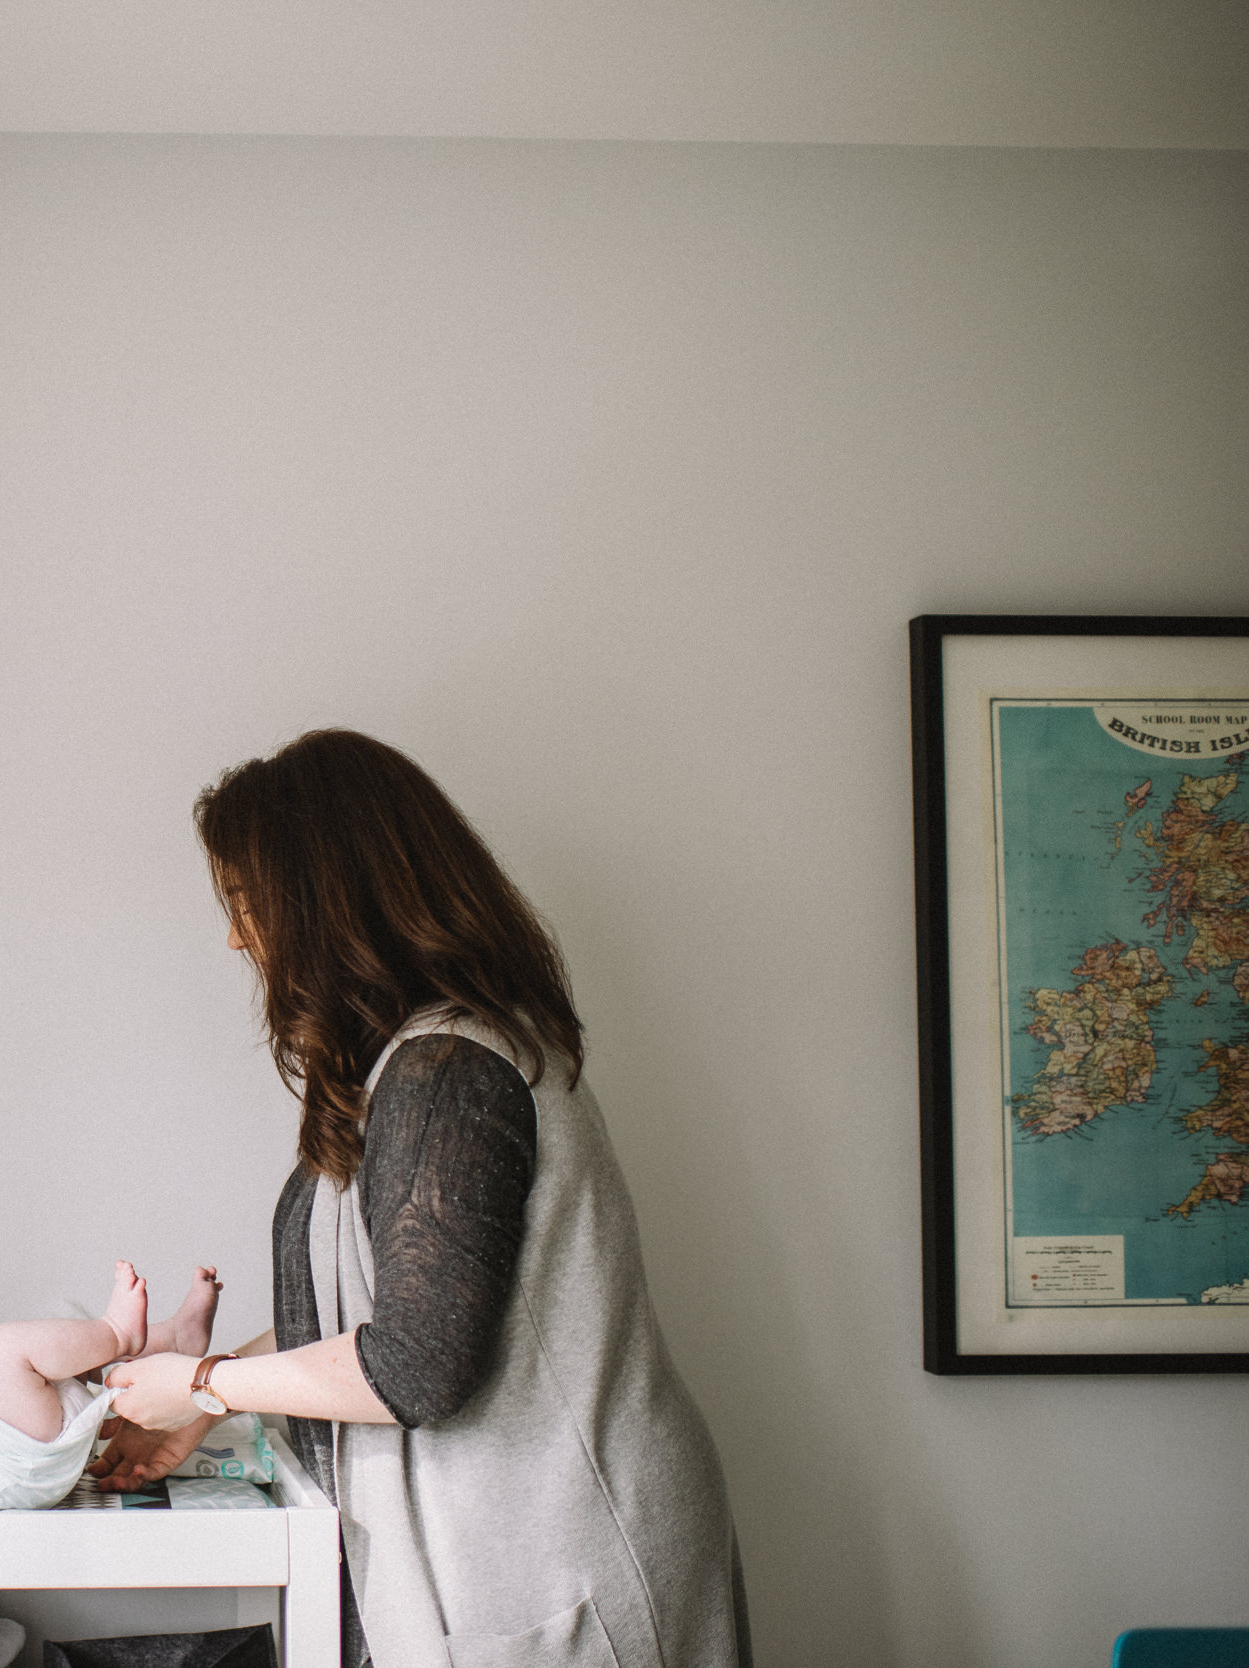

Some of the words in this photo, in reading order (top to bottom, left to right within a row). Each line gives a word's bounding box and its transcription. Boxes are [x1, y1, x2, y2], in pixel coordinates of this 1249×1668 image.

[1141, 715, 1185, 724] SCHOOL
[1189, 715, 1221, 724] ROOM
[1225, 716, 1248, 725] MAP
[1108, 717, 1201, 753] BRITISH
[1210, 728, 1249, 751] ISL
